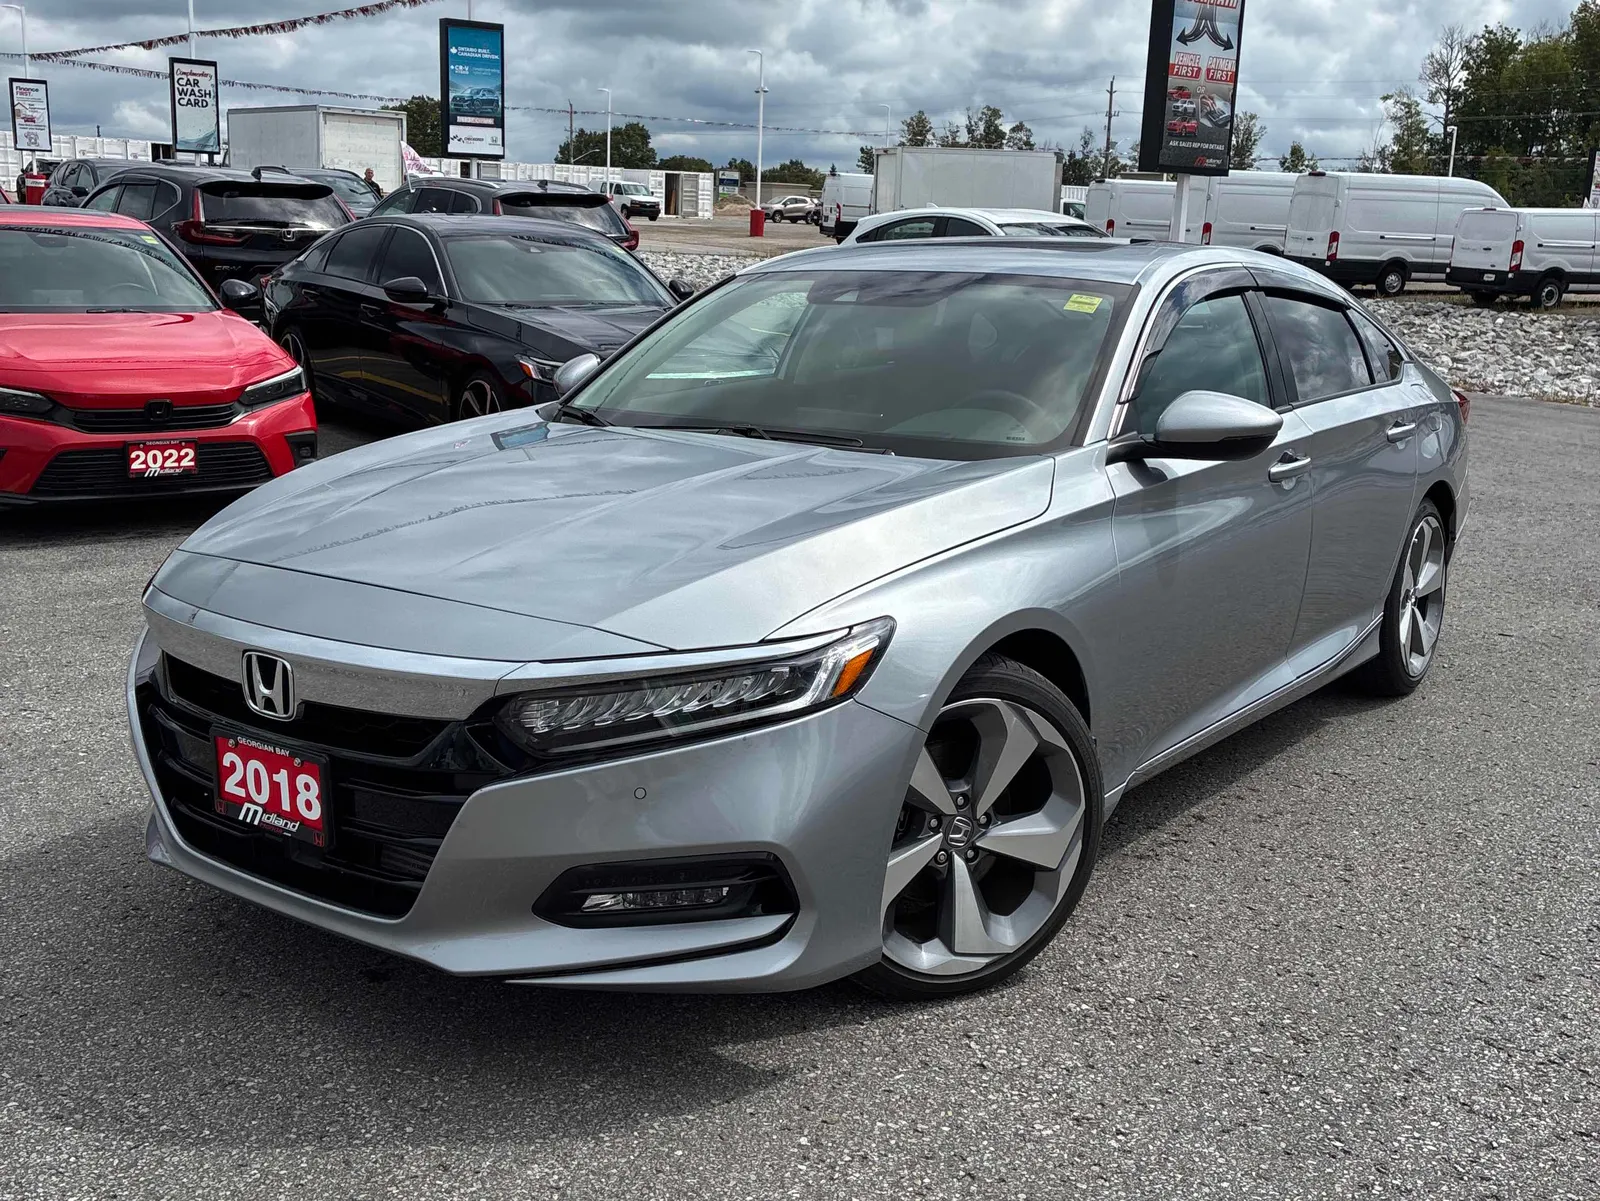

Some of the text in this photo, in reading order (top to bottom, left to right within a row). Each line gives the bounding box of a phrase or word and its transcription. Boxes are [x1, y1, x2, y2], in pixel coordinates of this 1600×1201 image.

[1175, 52, 1201, 66] VEHICLE
[1173, 65, 1199, 78] FIRST
[1208, 69, 1233, 81] FIRST
[176, 77, 200, 88] CAR
[176, 87, 212, 99] WASH
[177, 97, 209, 108] CARD
[130, 448, 195, 469] 2022
[237, 736, 290, 757] GEORGIAN BAY
[222, 751, 322, 821] 2018
[237, 801, 301, 833] Midland
